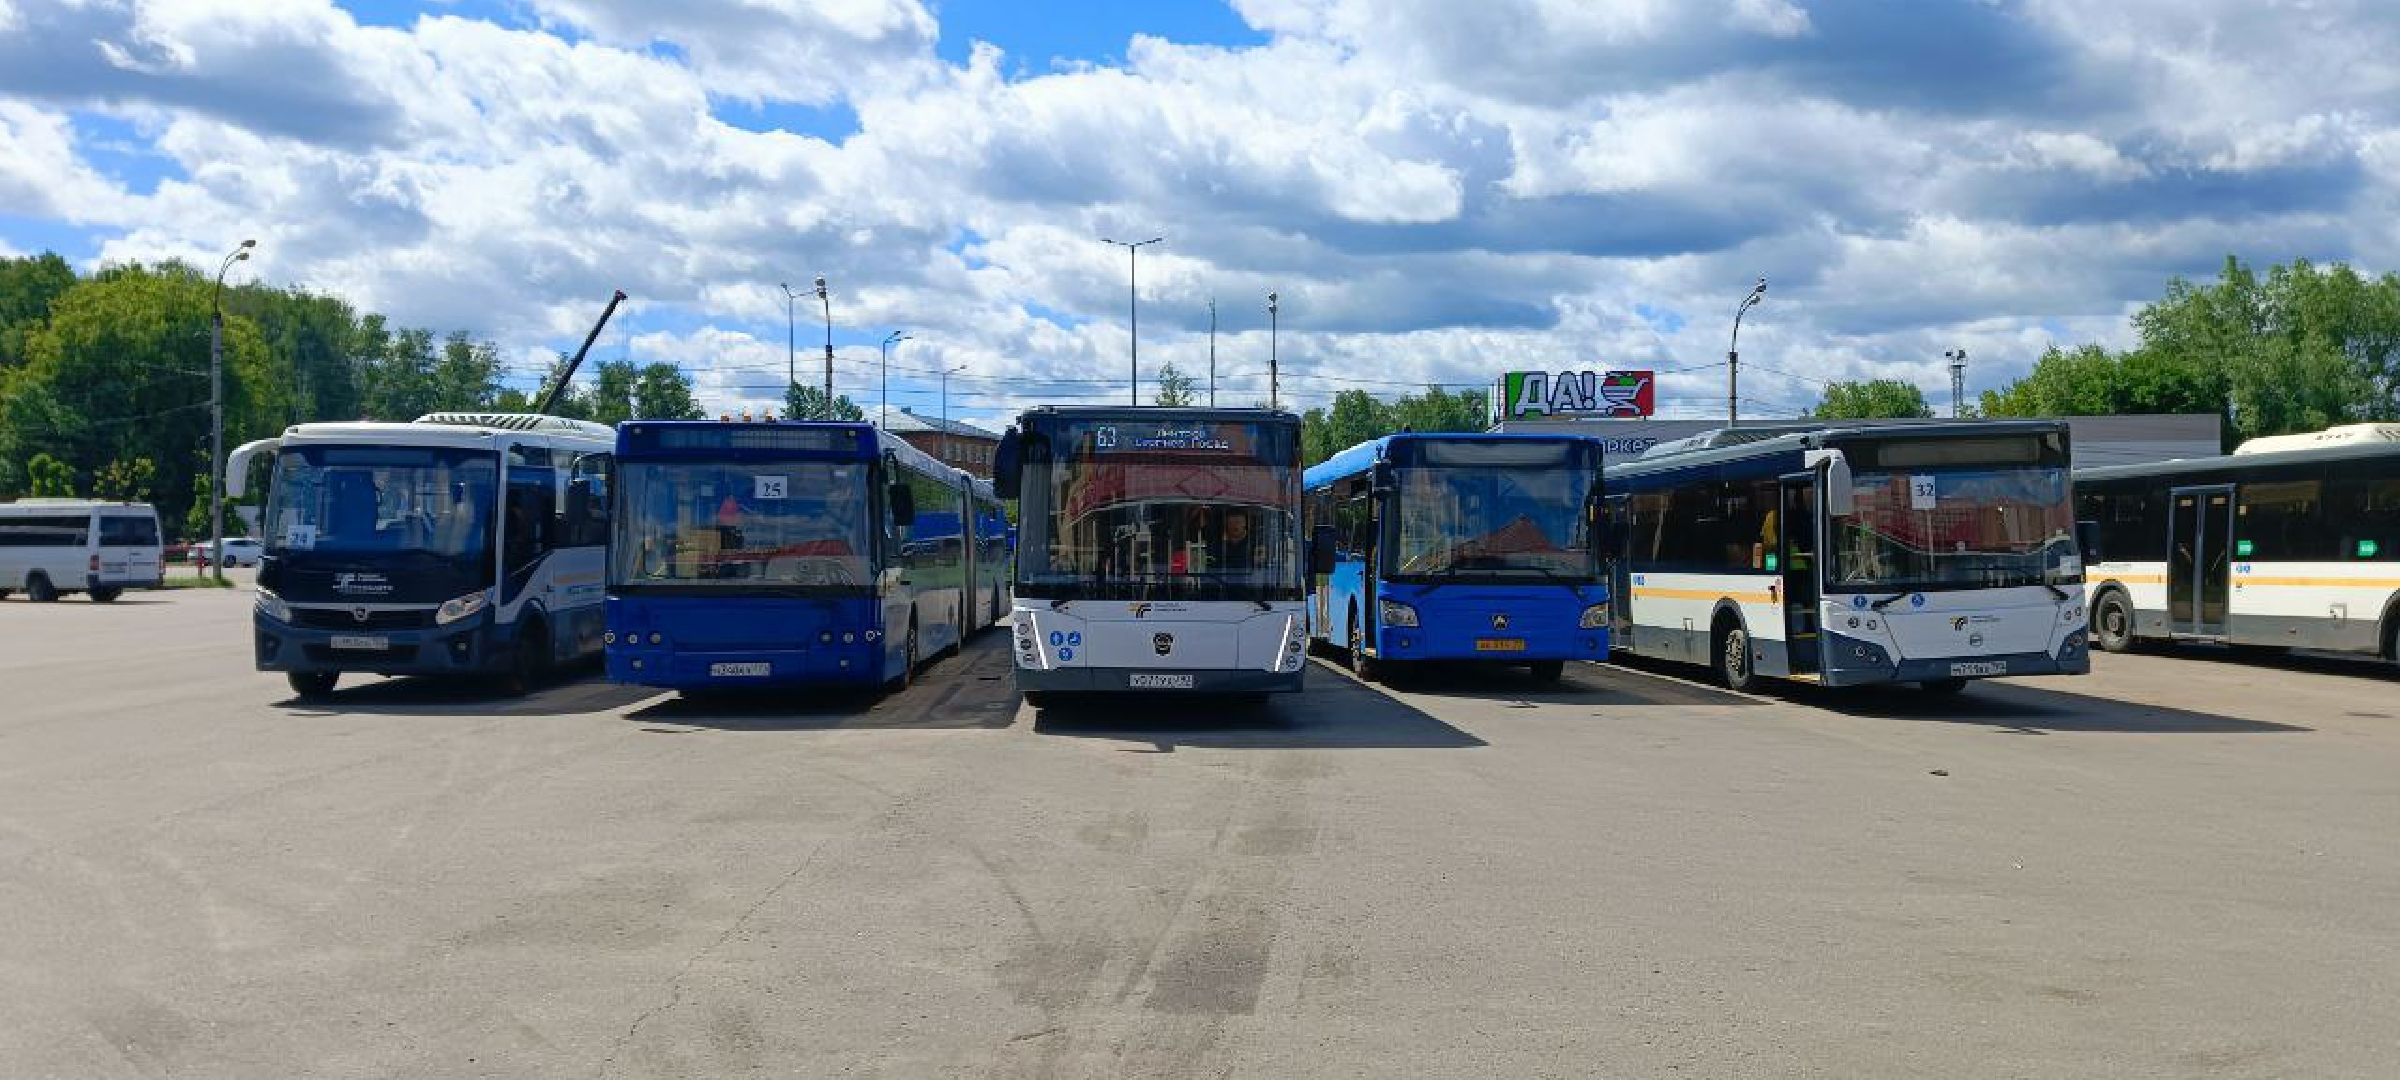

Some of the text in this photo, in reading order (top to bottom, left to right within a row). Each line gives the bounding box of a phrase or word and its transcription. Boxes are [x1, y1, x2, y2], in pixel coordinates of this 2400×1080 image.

[1515, 371, 1595, 416] ДА!
[1098, 427, 1115, 446] 63
[762, 482, 781, 496] 25
[1915, 483, 1934, 496] 32
